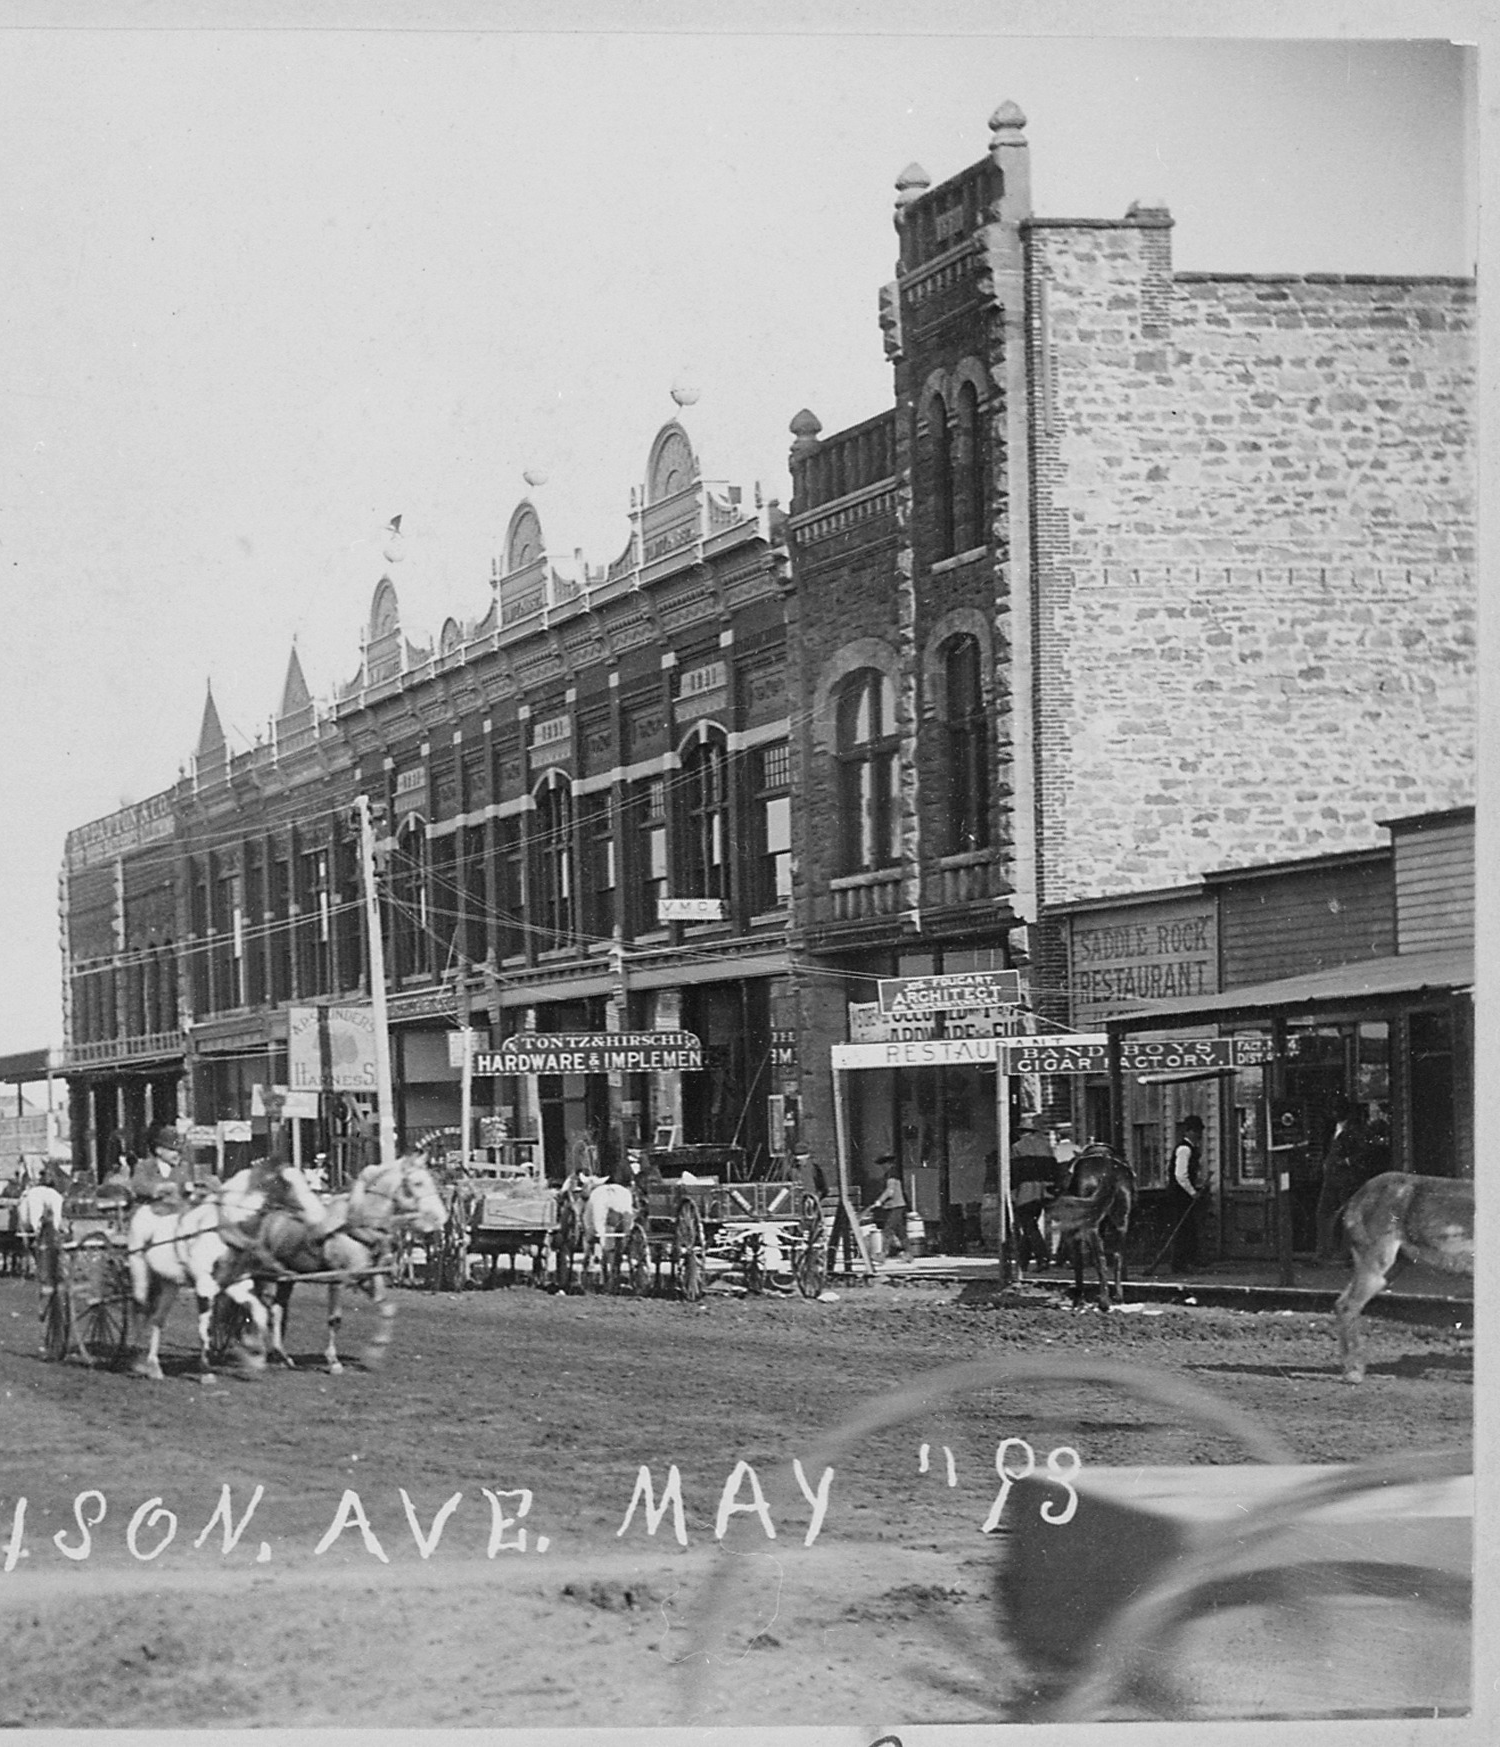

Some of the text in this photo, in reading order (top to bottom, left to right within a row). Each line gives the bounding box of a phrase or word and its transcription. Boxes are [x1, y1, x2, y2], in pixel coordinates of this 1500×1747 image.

[1081, 918, 1208, 960] SADDLE ROCK
[1080, 961, 1208, 1003] RESTAURANT
[894, 985, 1002, 1005] ARCHITECT
[1023, 1042, 1212, 1059] BAND BOYS
[477, 1051, 701, 1073] HARDWARE & IMPLEMEN
[1017, 1058, 1092, 1072] CIGAR
